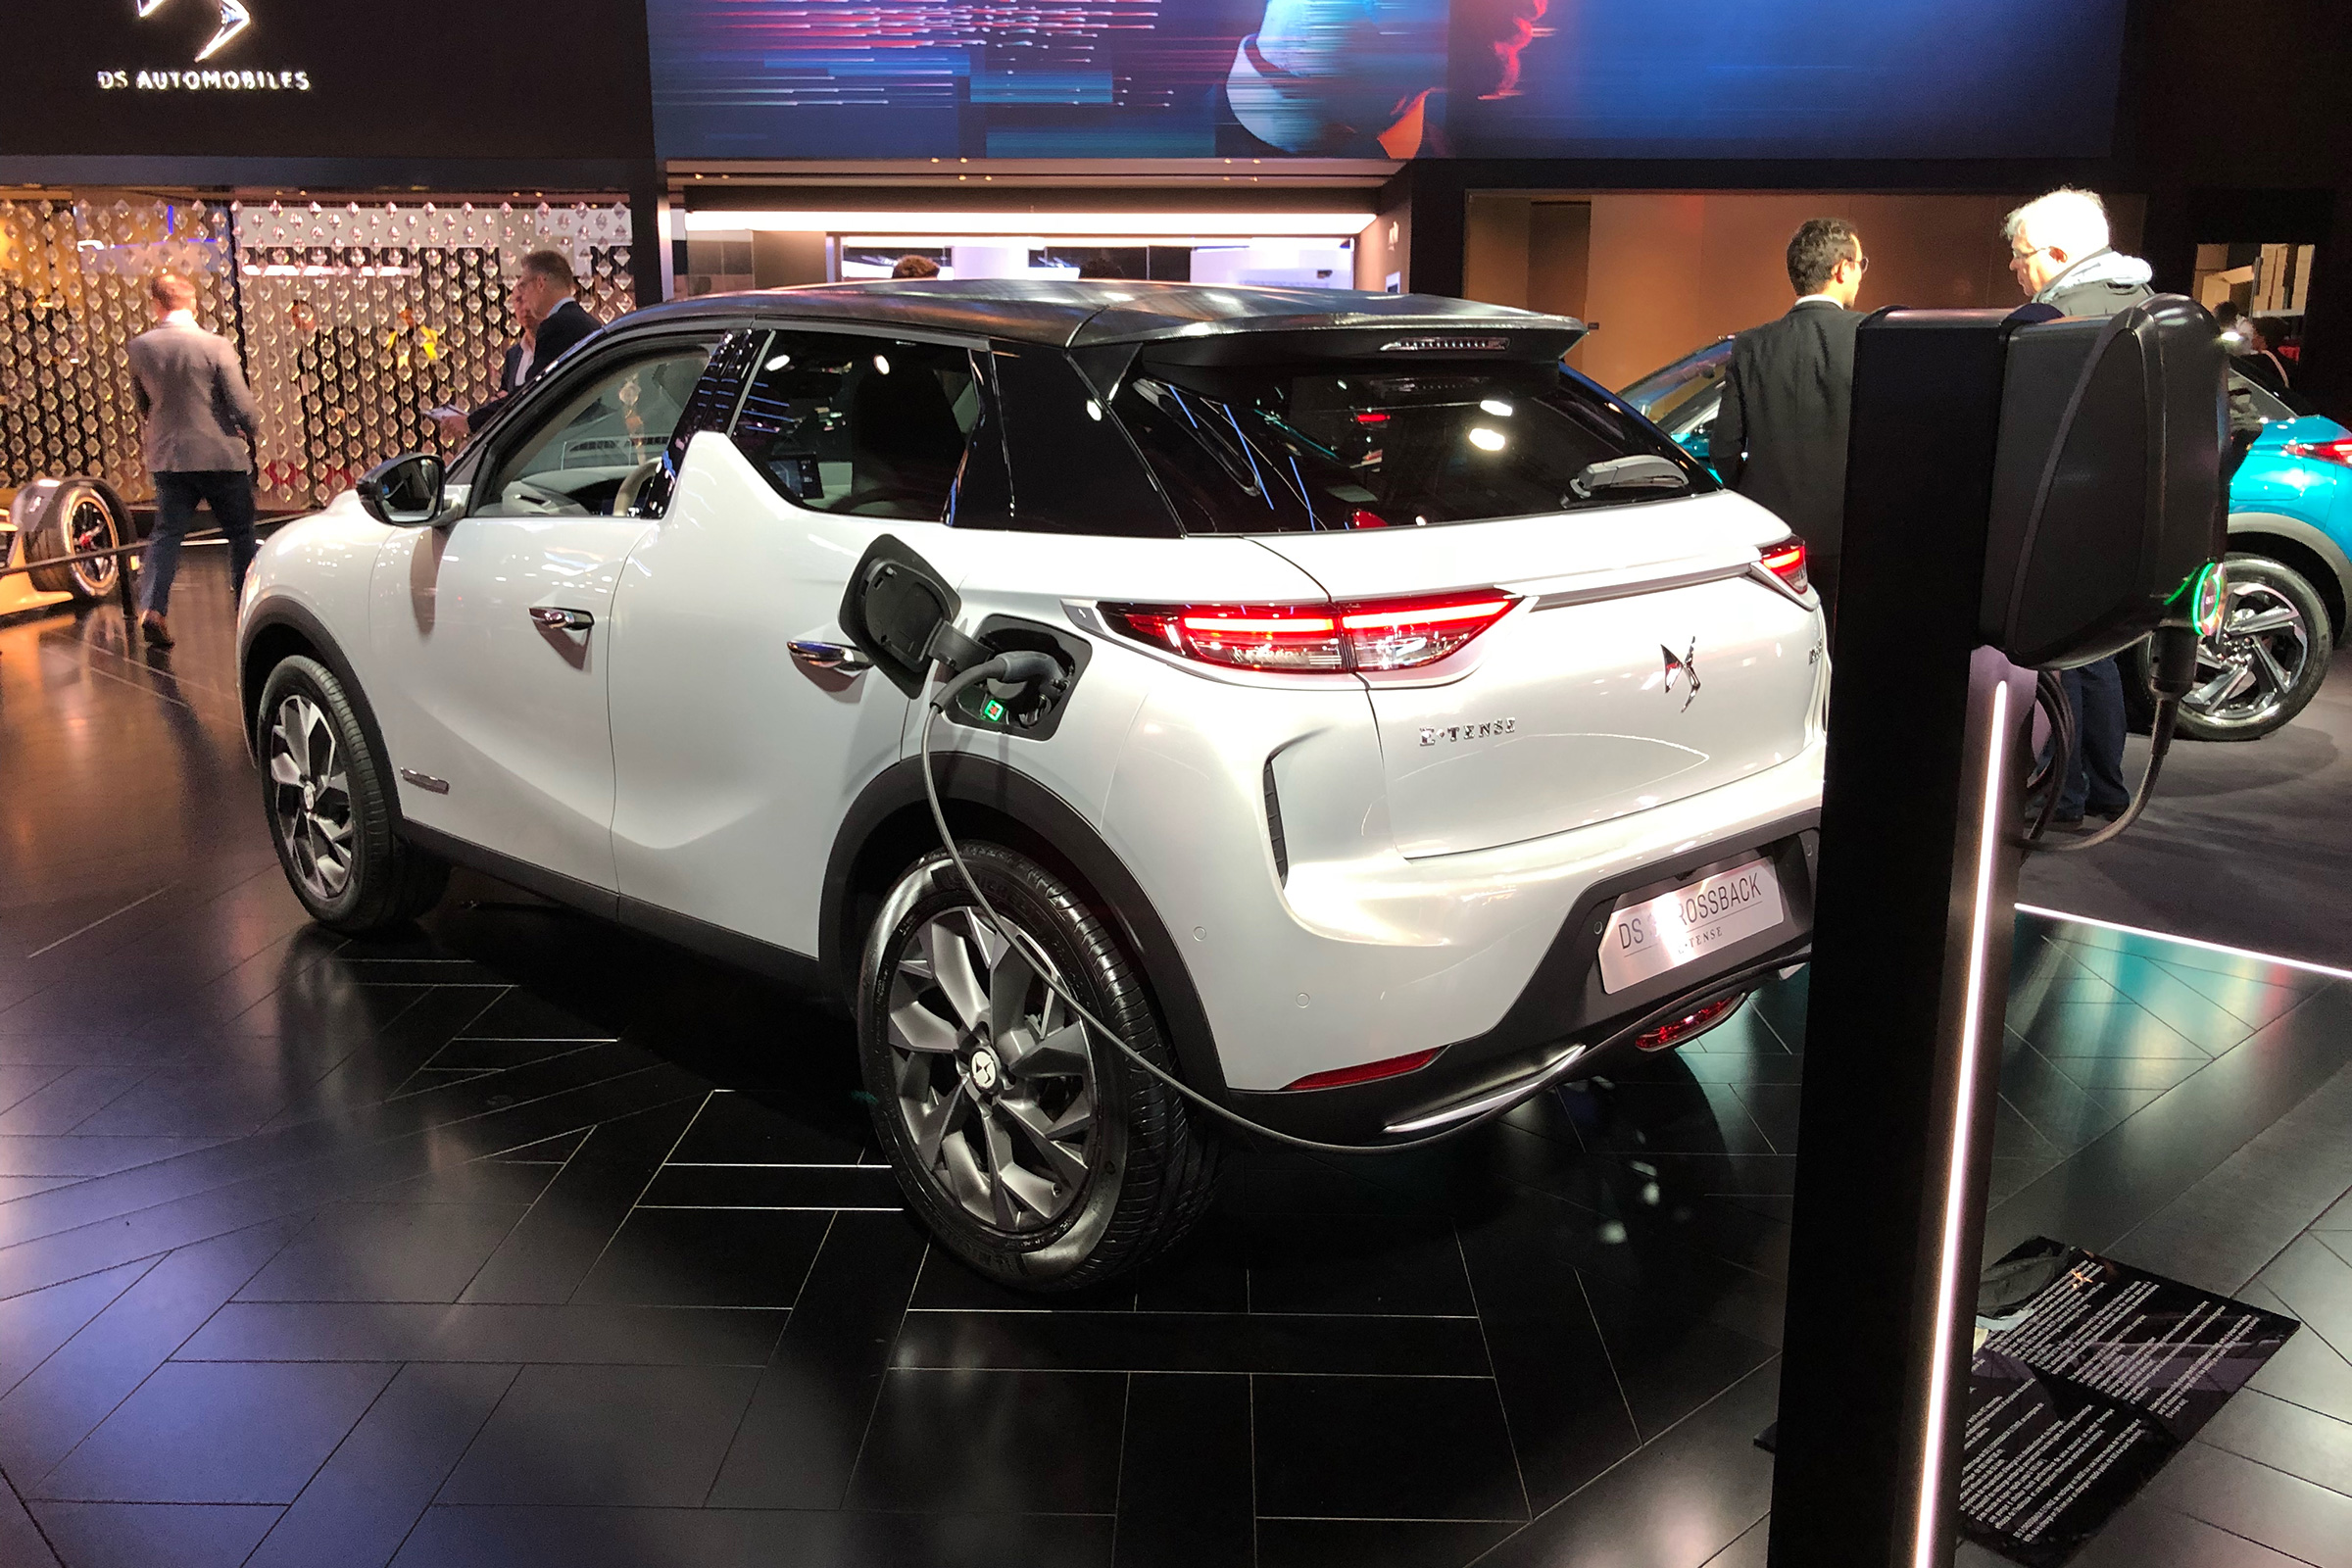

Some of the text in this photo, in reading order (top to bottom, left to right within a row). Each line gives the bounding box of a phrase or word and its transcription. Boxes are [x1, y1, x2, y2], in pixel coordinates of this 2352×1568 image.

[97, 71, 312, 91] DS AUTOMOBILES
[1618, 917, 1643, 950] DS
[1672, 872, 1762, 927] ROSSBACK
